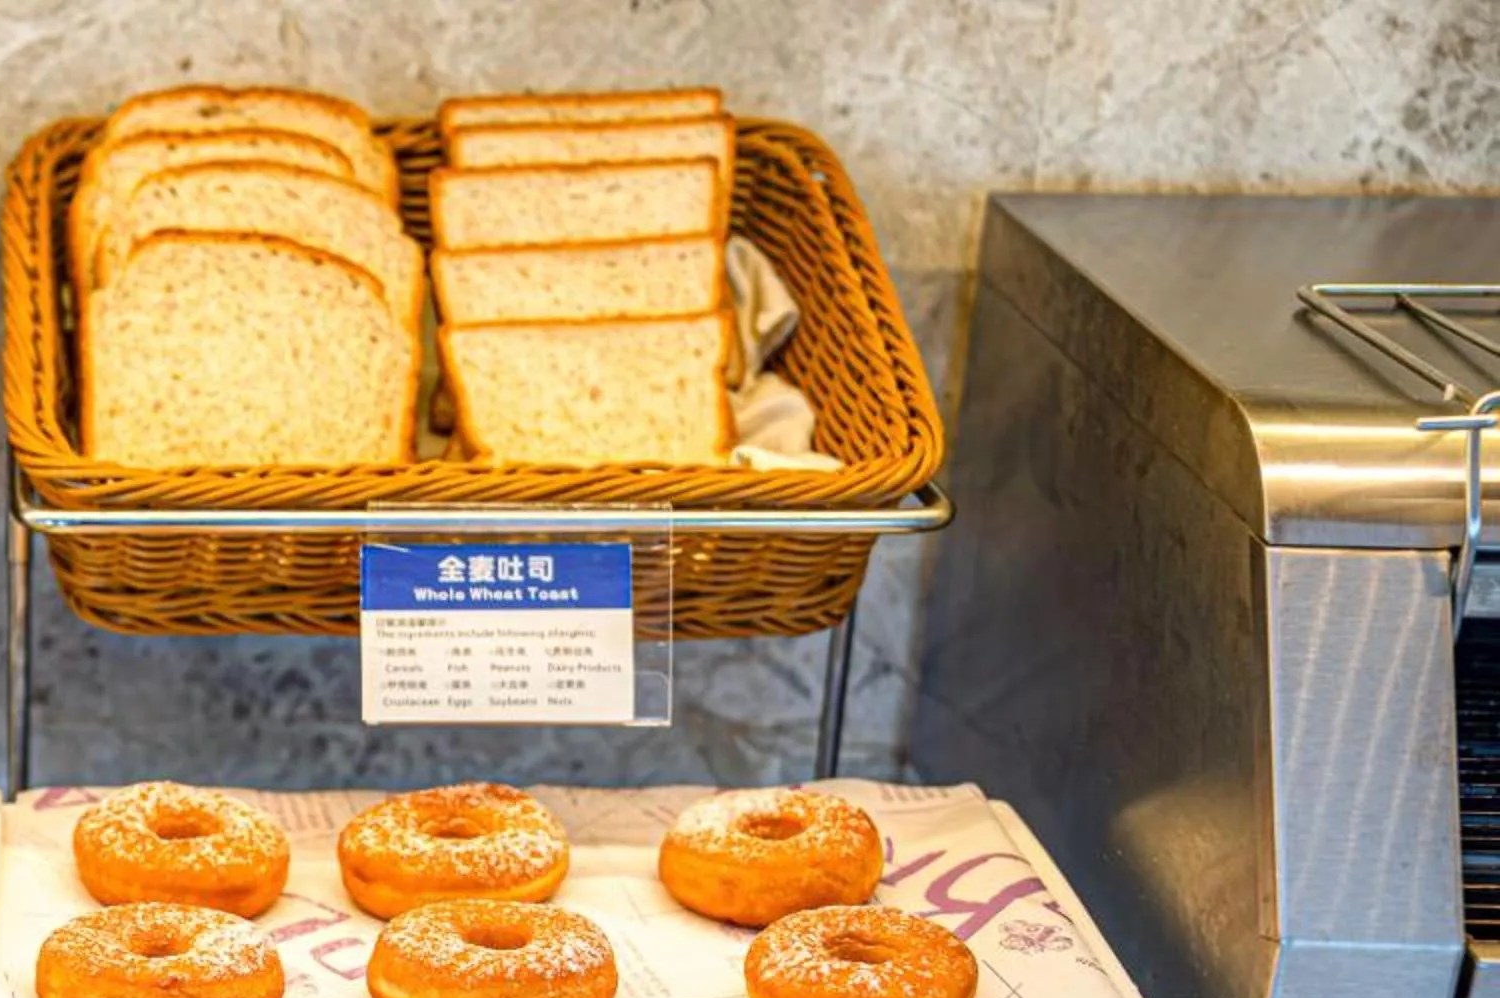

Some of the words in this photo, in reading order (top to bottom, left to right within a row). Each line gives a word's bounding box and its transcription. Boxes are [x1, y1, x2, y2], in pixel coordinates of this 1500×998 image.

[438, 554, 554, 583] 全麦吐司
[413, 587, 465, 601] Whole
[469, 587, 523, 601] Wheat
[527, 587, 579, 601] Toast
